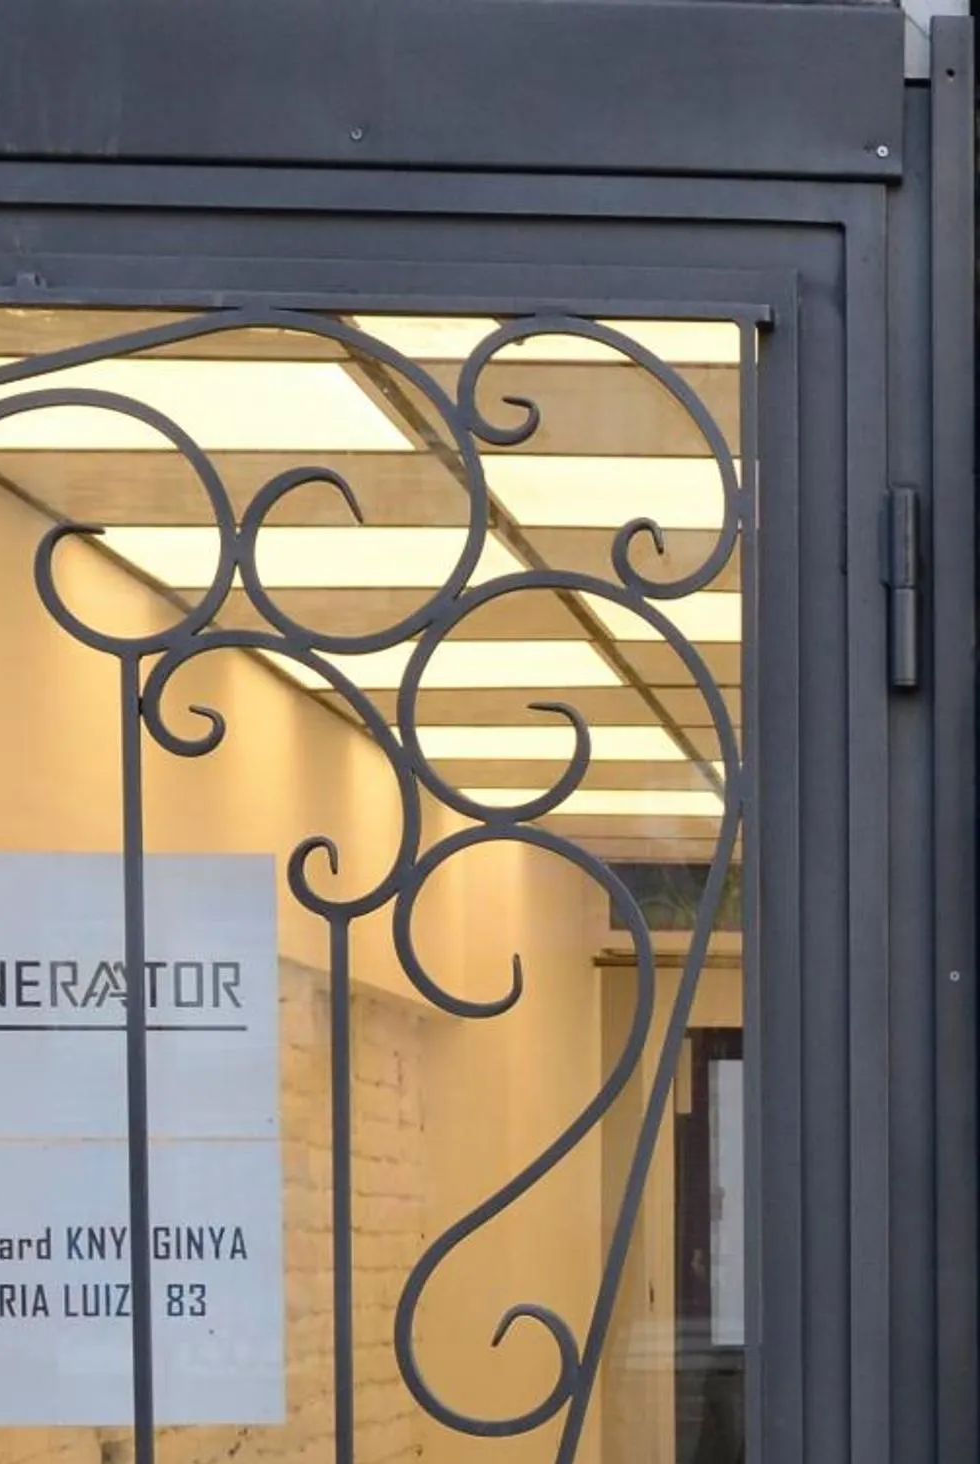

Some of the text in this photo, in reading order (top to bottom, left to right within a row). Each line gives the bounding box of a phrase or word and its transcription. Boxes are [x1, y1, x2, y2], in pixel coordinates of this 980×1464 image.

[66, 1226, 248, 1260] KNYGINYA
[63, 1283, 150, 1318] LUIZ
[166, 1283, 207, 1317] 83
